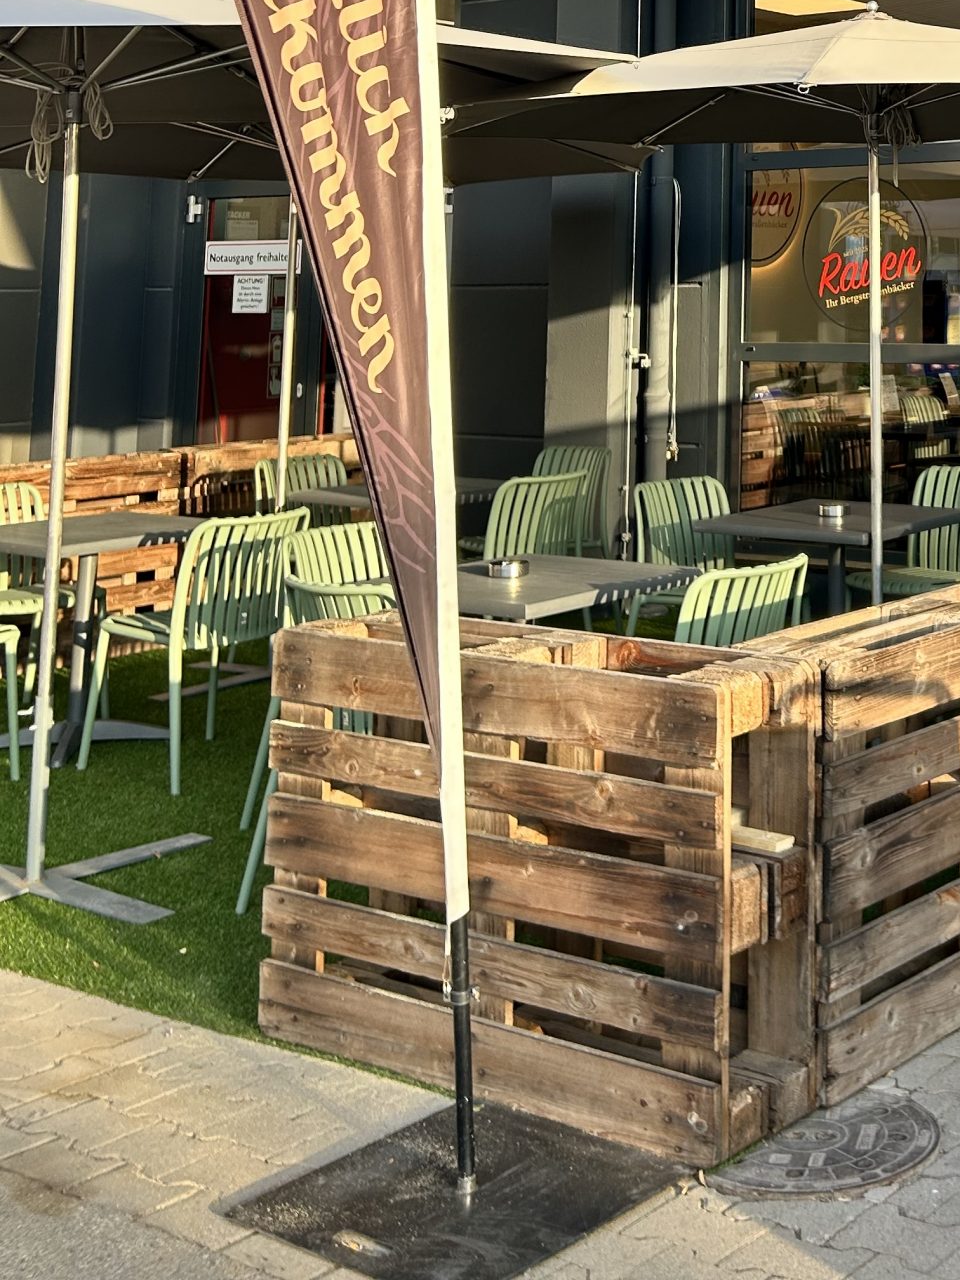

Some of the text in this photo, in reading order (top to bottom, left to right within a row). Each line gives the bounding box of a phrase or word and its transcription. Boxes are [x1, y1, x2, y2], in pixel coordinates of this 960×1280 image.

[209, 251, 289, 265] Notausgang freihalte
[826, 281, 915, 308] Ihr Bergstrnbäcker
